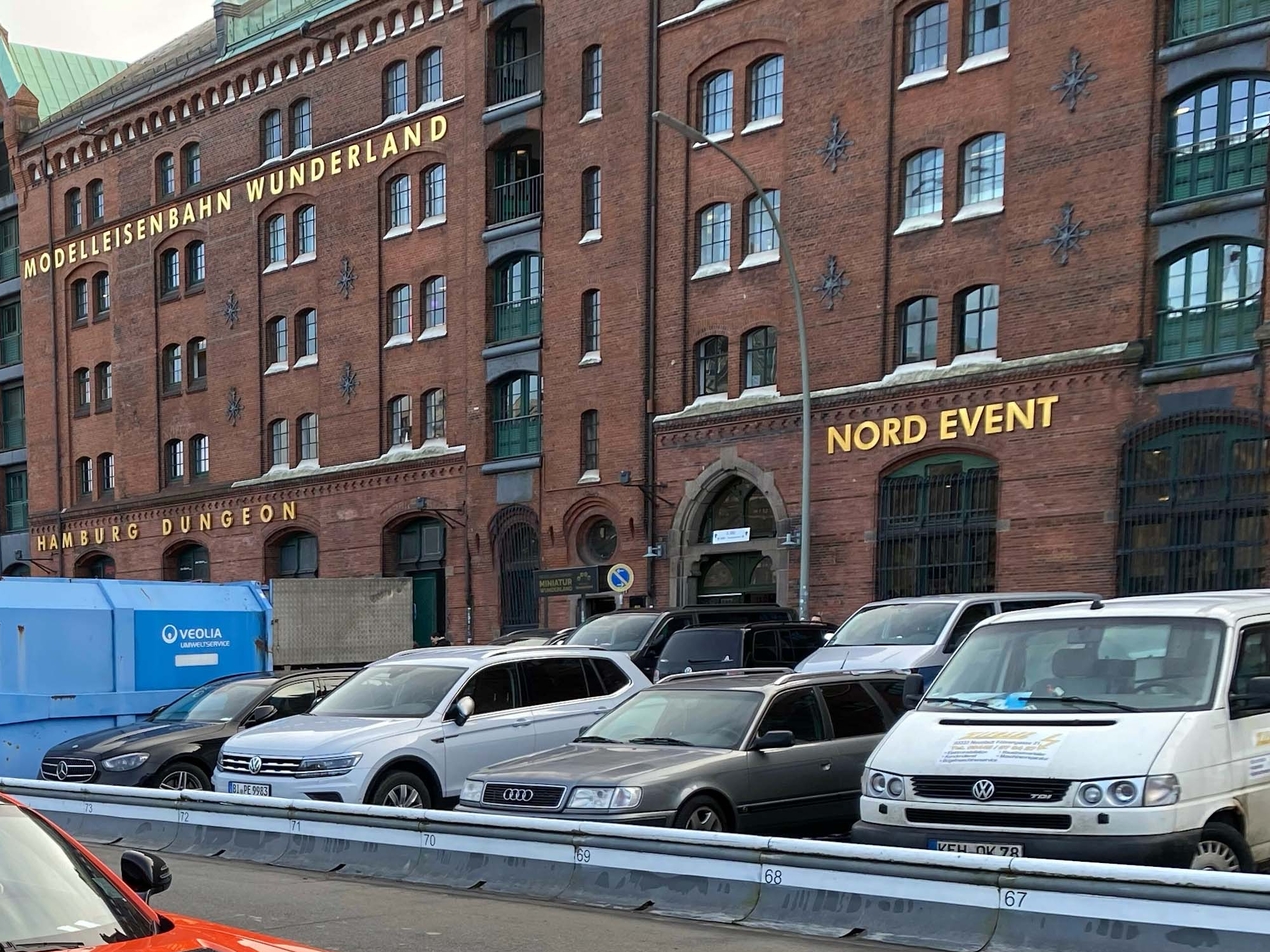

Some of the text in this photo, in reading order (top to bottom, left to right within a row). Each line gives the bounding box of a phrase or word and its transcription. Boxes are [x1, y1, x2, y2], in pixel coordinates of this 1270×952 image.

[24, 115, 449, 279] MODELLEISENBAHN WUNDERLAND
[827, 395, 1059, 454] NORD EVENT
[37, 501, 297, 552] HAMBURG DUNGEON
[539, 577, 573, 588] MINIATUR
[180, 628, 222, 639] VEOLIA
[180, 640, 230, 648] UMWELTSERVICE
[84, 803, 93, 814] 73
[180, 812, 189, 823] 72
[291, 821, 301, 832] 71
[424, 834, 436, 847] 70
[576, 848, 591, 863] 69
[764, 868, 783, 885] 68
[1005, 890, 1027, 908] 67
